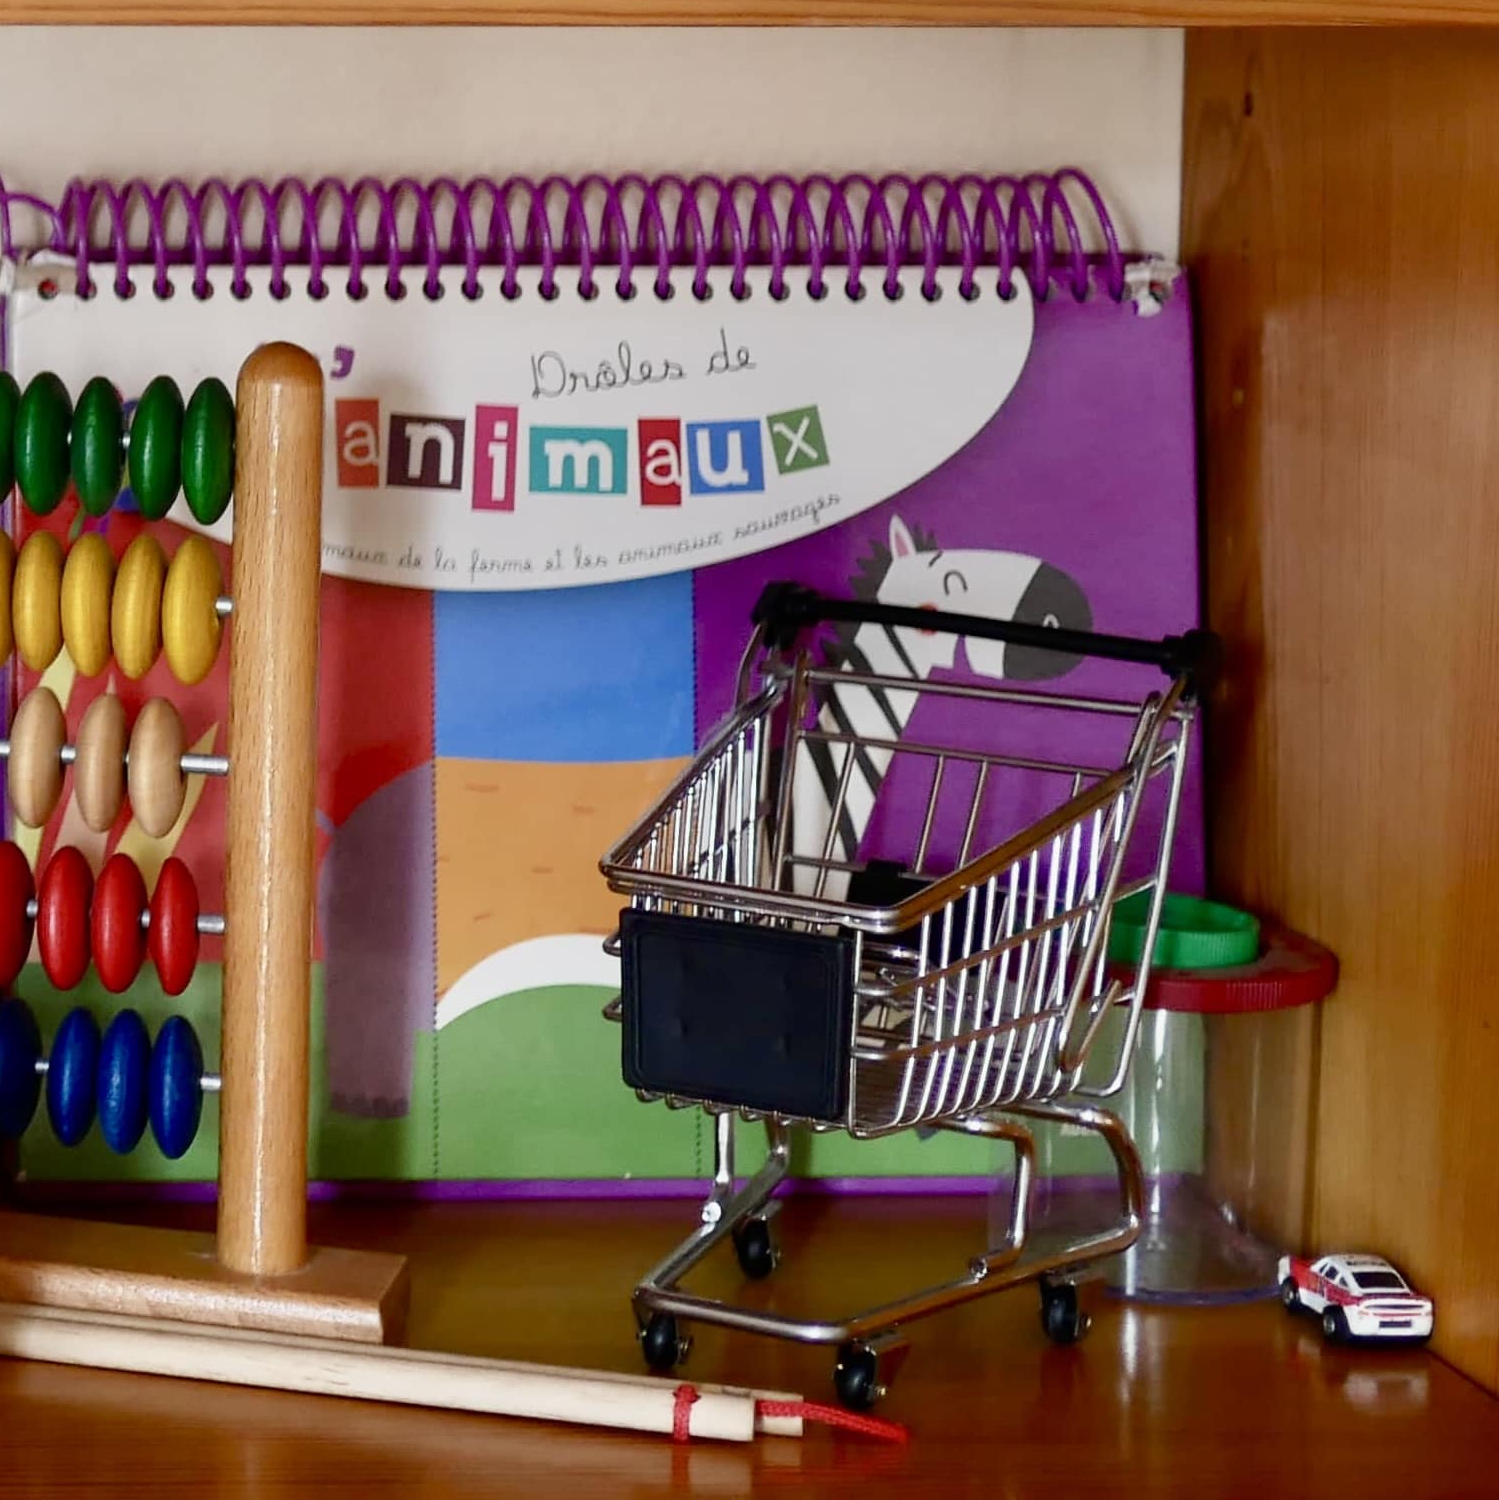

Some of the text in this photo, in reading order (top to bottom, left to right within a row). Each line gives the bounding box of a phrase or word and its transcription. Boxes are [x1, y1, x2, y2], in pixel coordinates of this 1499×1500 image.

[530, 328, 758, 400] Drôles de
[321, 542, 389, 563] maux
